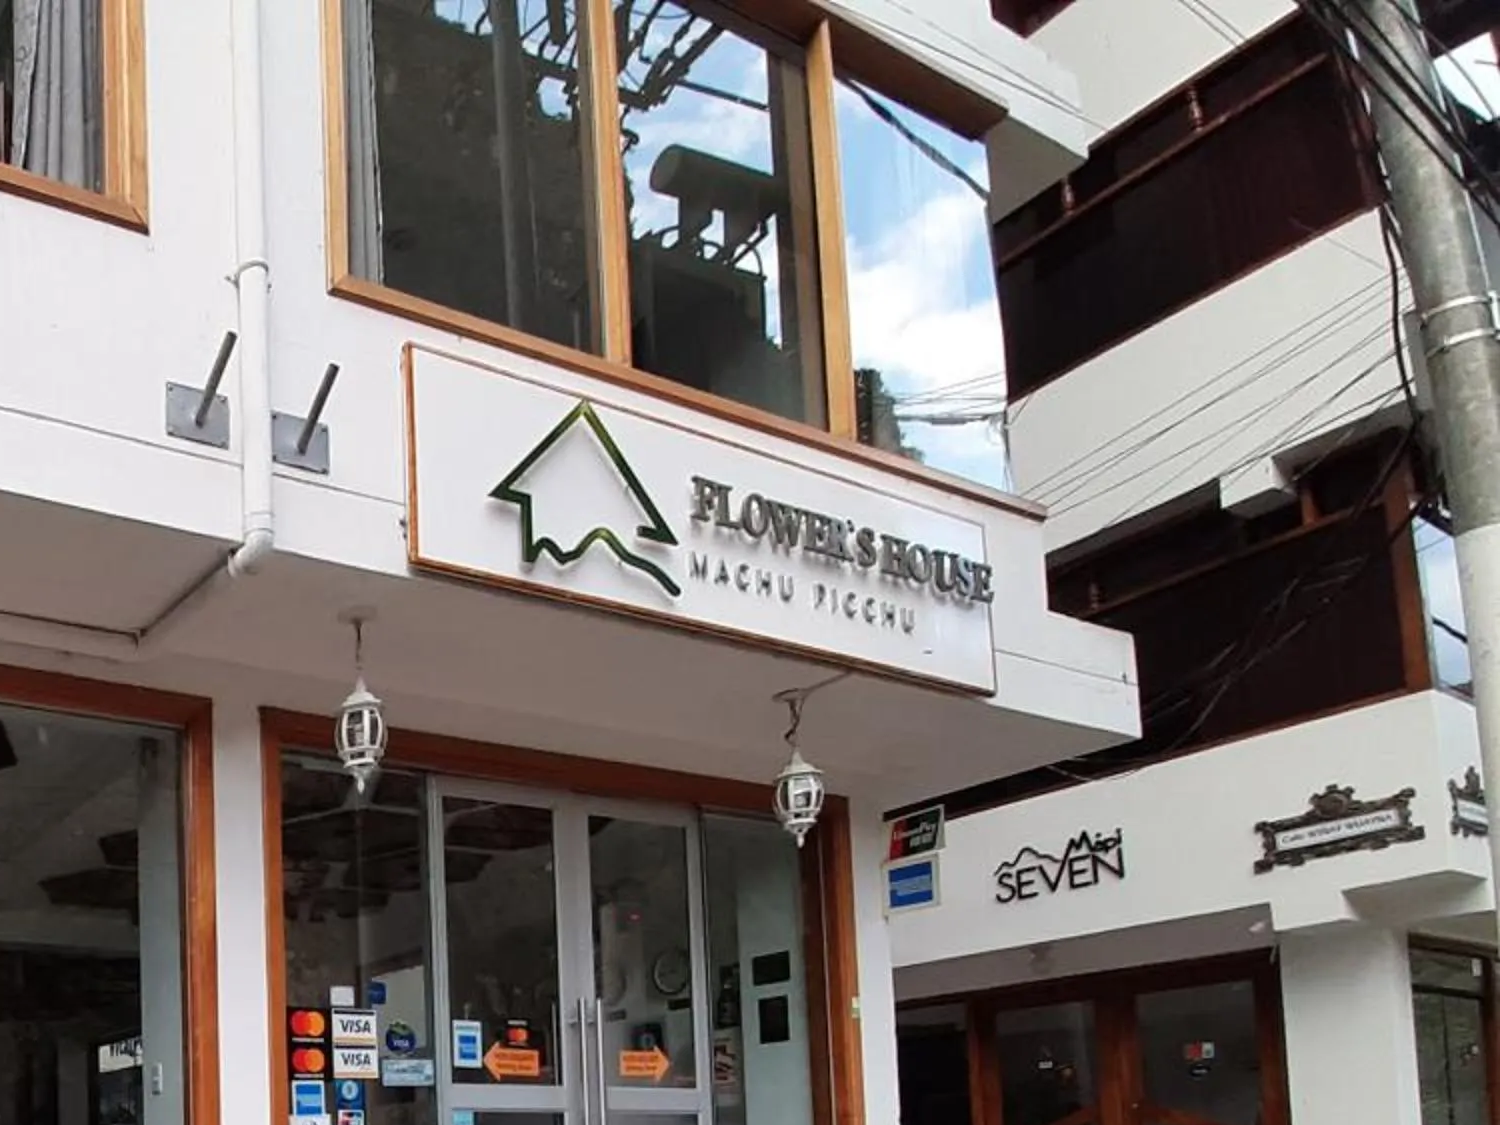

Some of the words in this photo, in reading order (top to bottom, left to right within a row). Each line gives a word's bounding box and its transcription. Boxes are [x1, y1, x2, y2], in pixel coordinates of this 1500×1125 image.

[690, 474, 877, 568] FLOWER'S
[880, 532, 995, 604] HOUSE
[689, 550, 795, 603] MACHU
[812, 582, 916, 635] PICCHU
[995, 846, 1125, 903] SEVEN
[339, 1019, 371, 1034] VISA
[341, 1052, 372, 1066] VISA
